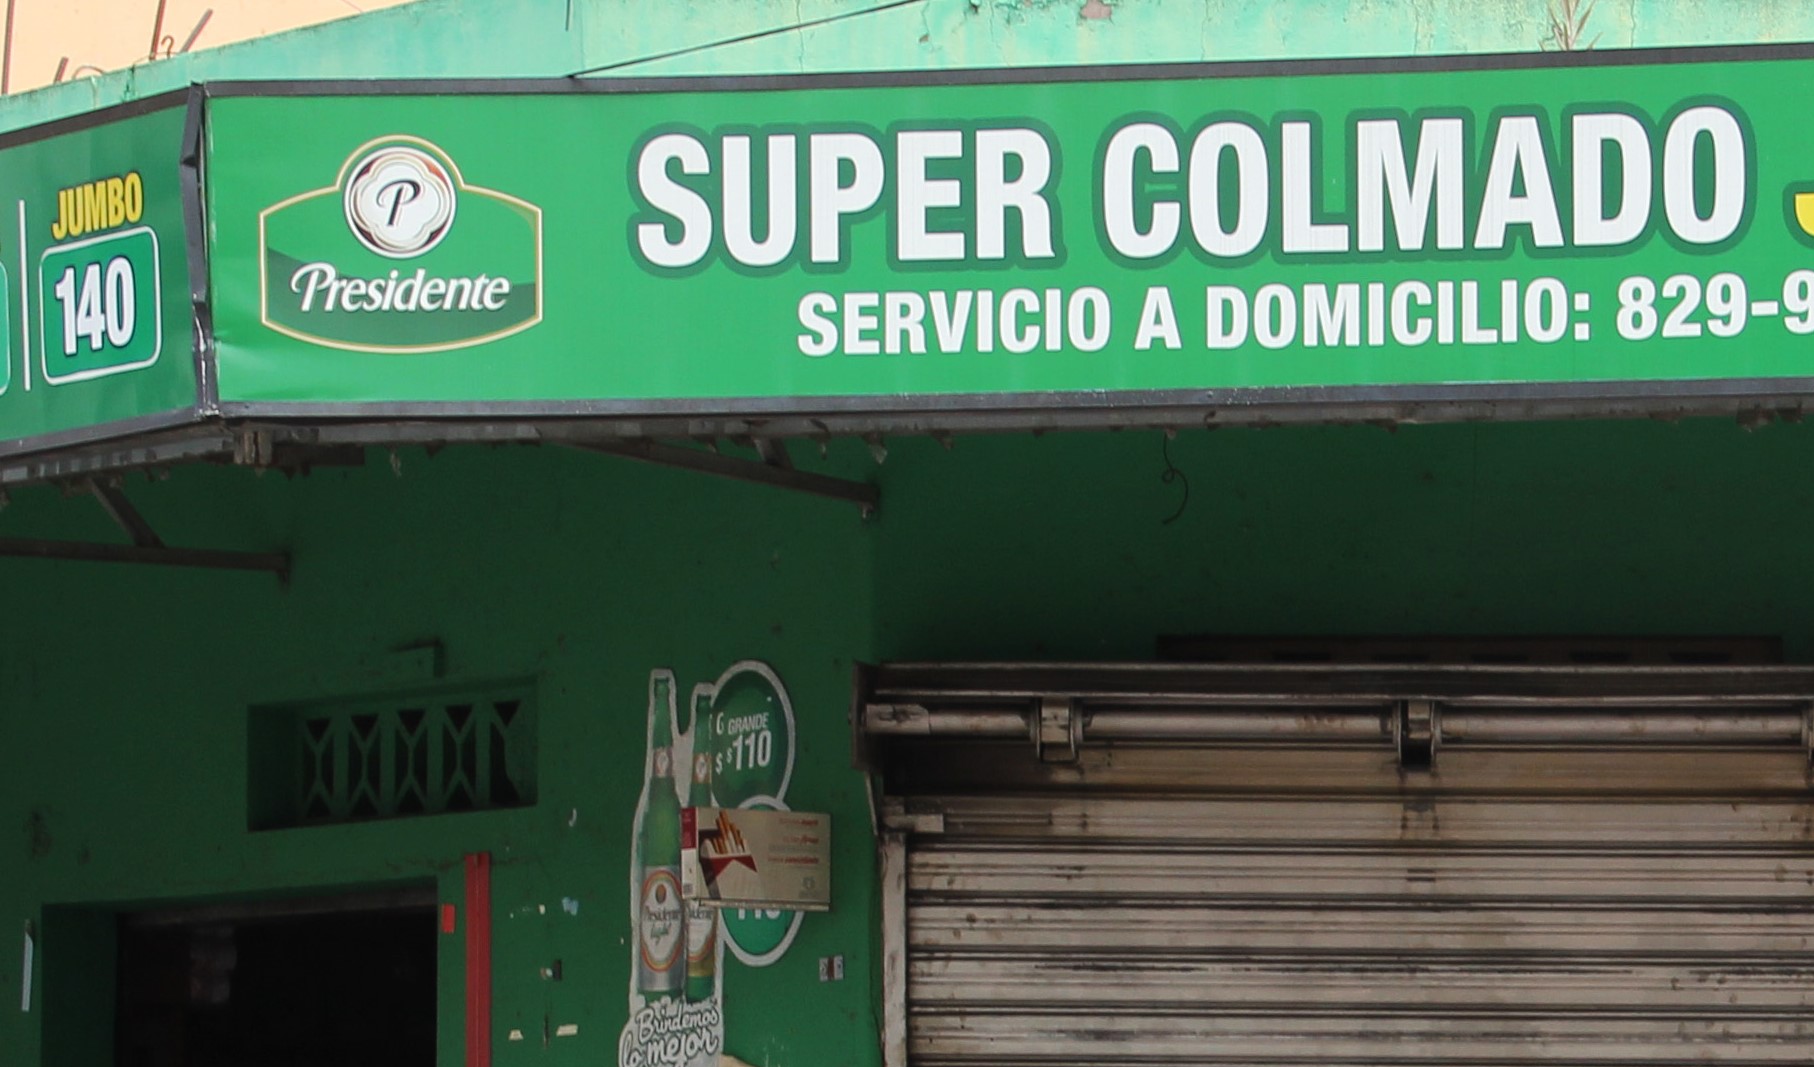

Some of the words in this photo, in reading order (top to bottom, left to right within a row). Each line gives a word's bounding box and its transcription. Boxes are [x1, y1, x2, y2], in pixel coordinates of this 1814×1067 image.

[52, 172, 144, 241] JUMBO
[636, 128, 1056, 268] SUPER
[1102, 106, 1746, 260] COLMADO
[54, 255, 136, 357] 140
[290, 261, 511, 314] Presidente
[797, 287, 1111, 358] SERVICIO
[1135, 286, 1182, 350] A
[1206, 277, 1592, 351] DOMICILIO:
[728, 712, 769, 735] GRANDE
[636, 1004, 719, 1043] Brindemos
